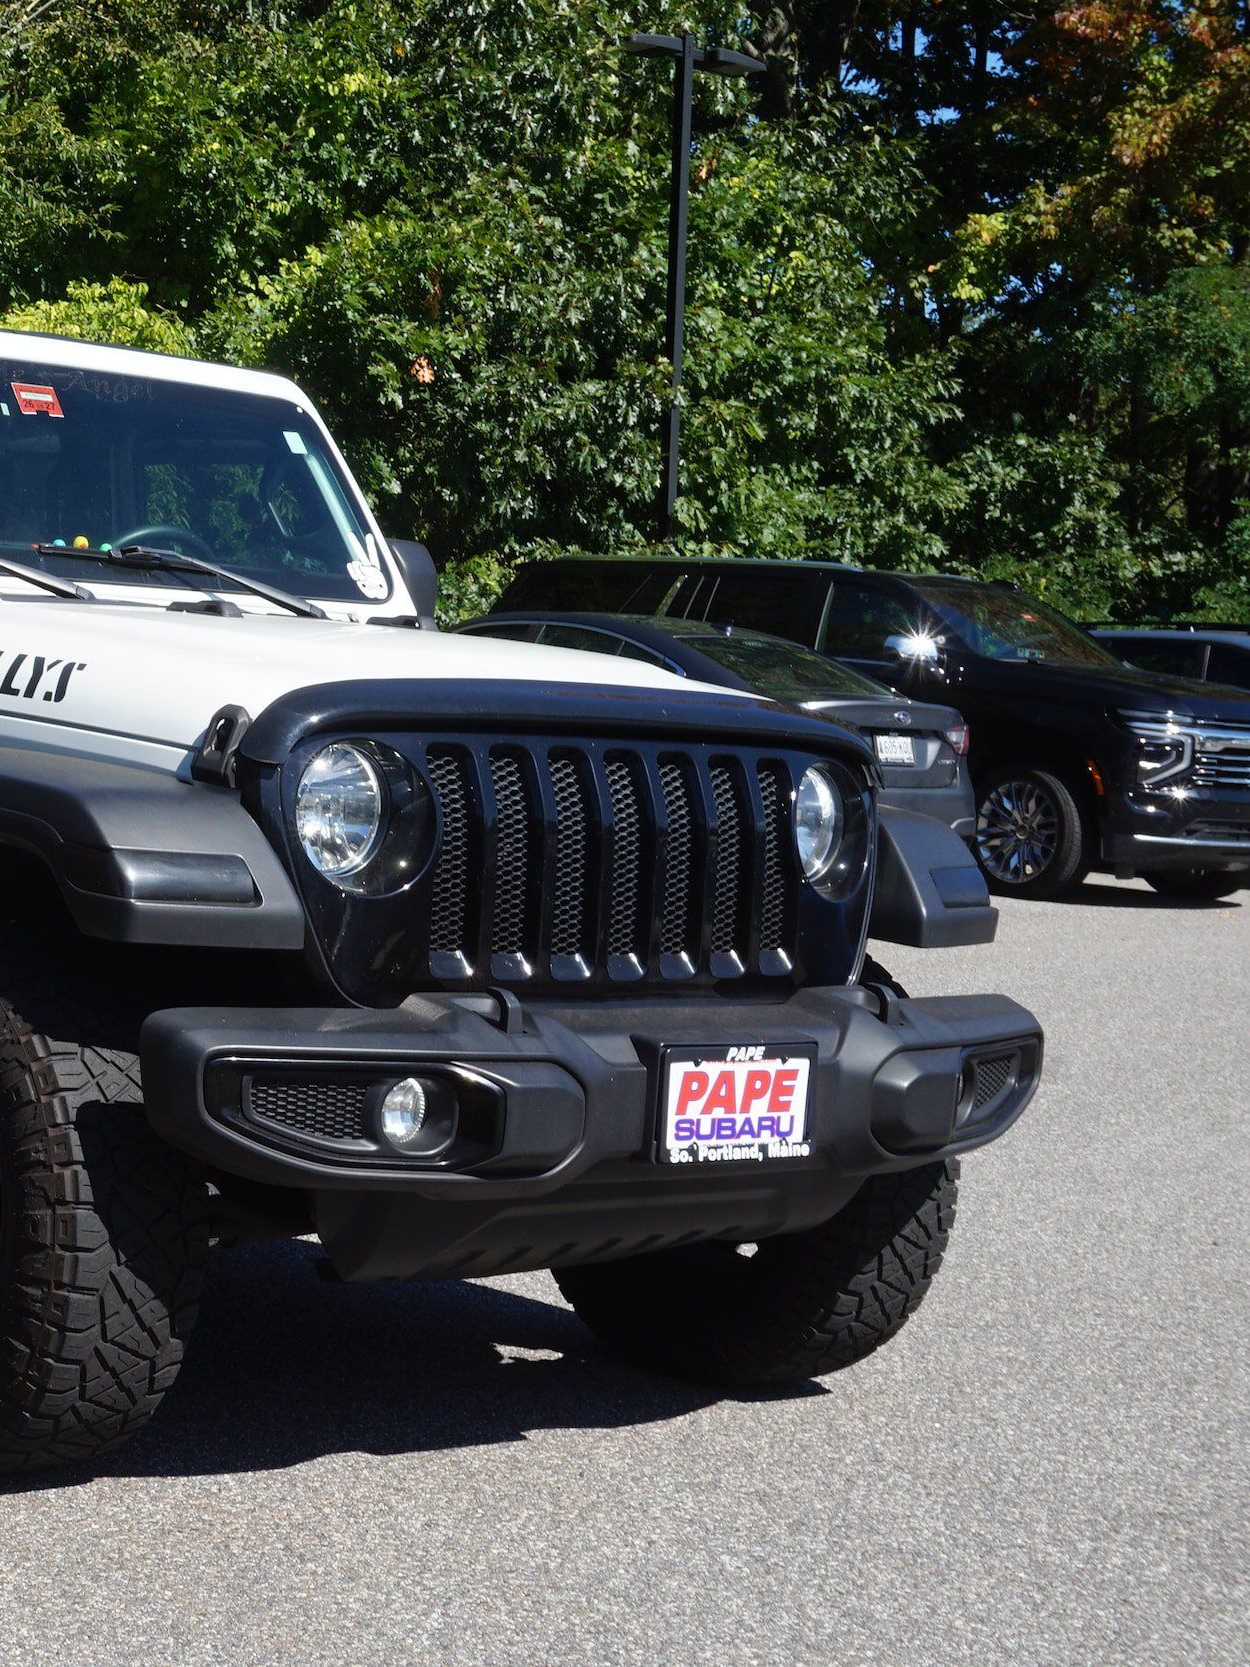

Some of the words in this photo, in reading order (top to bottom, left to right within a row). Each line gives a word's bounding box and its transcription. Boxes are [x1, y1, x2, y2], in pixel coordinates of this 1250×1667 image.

[726, 1046, 767, 1062] PAPE
[675, 1069, 800, 1116] PAPE
[674, 1115, 794, 1142] SUBARU
[669, 1147, 693, 1164] So.
[698, 1142, 763, 1163] Portland,
[767, 1142, 811, 1160] Maine
